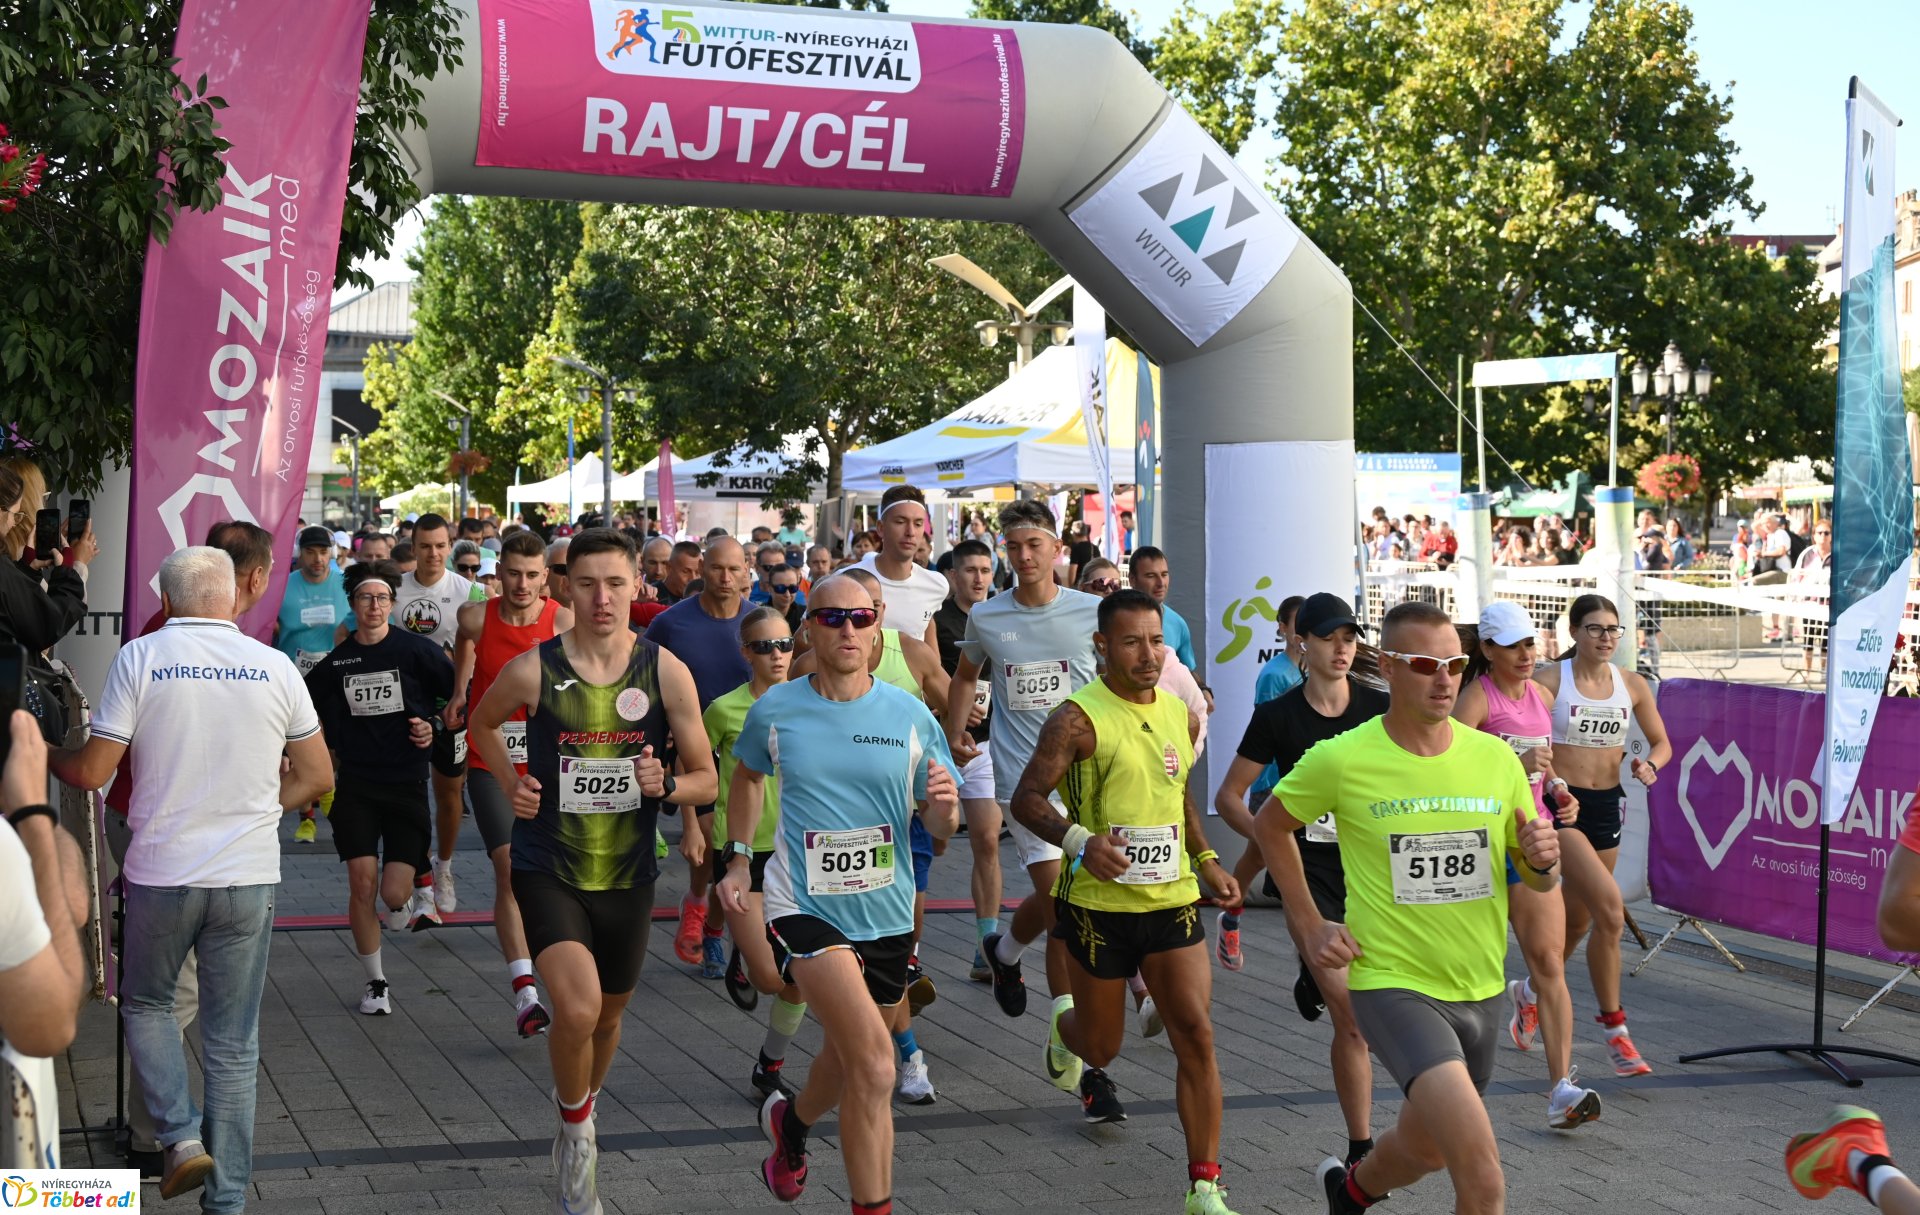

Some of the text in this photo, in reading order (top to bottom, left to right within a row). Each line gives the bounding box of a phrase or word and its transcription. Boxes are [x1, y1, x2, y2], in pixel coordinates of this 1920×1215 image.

[703, 23, 909, 51] WITTUR-NYÍREGYHÁZI
[496, 18, 510, 127] www.mozaikmed.hu
[662, 41, 912, 82] FUTÓFESZTIVÁL
[990, 34, 1011, 188] www.nyiregyhazifutofesztival.hu
[582, 96, 925, 174] RAJT/CÉL
[274, 174, 300, 259] med
[1134, 228, 1192, 288] WITTUR
[197, 160, 273, 472] MOZAIK
[274, 269, 321, 482] Az orvosi futóközösség
[729, 475, 775, 491] KÄRC
[1856, 628, 1882, 653] Előre
[151, 663, 270, 683] NYÍREGYHÁZA
[300, 659, 320, 671] 50
[354, 685, 392, 702] 5175
[1016, 675, 1060, 695] 5059
[1841, 666, 1888, 695] mozdítju
[1578, 719, 1621, 735] 5100
[1860, 708, 1868, 726] a
[573, 775, 631, 795] 5025
[821, 847, 877, 872] 5031
[1125, 844, 1171, 865] 5029
[1408, 853, 1476, 879] 5188
[1752, 854, 1866, 890] Az orvosi futózösség
